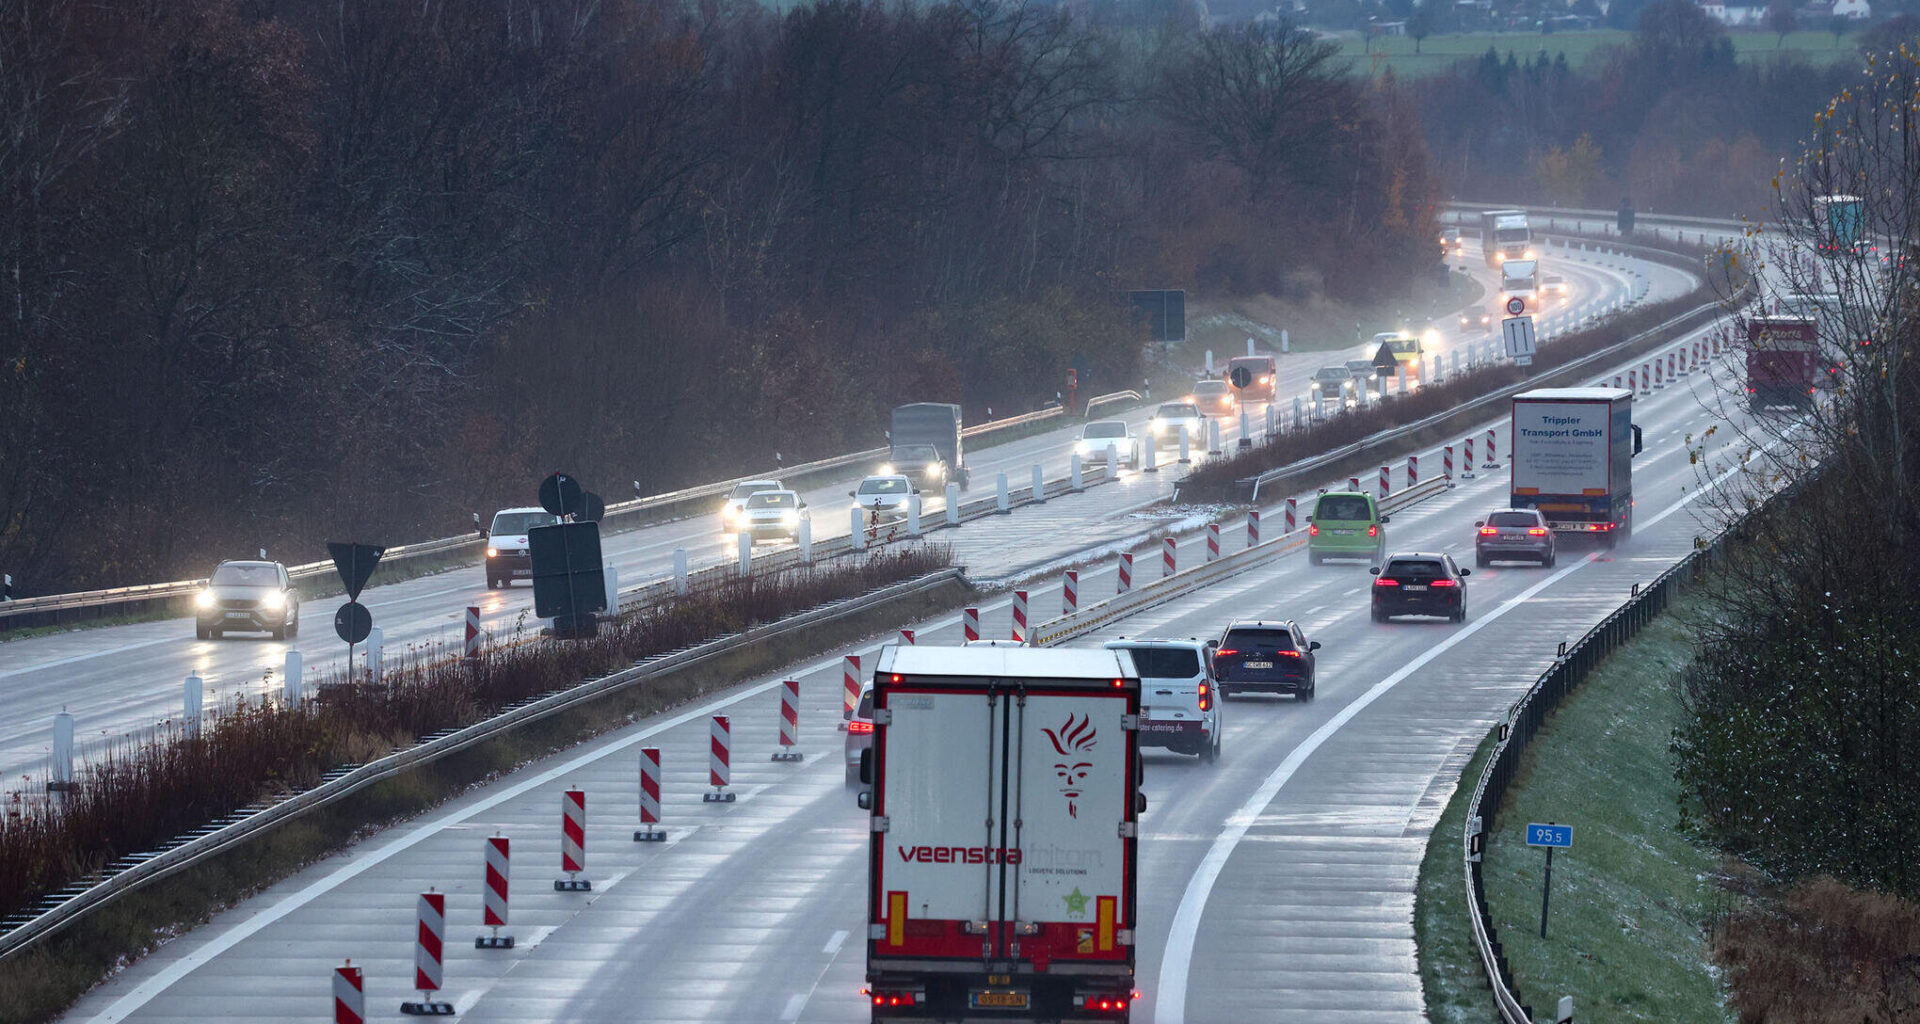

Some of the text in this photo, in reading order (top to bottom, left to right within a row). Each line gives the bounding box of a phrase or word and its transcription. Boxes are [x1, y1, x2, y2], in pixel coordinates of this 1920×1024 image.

[1510, 301, 1522, 311] 100
[1542, 415, 1581, 426] Trippler
[1521, 429, 1603, 438] Transport GmbH
[898, 845, 1023, 865] veenstra
[1056, 867, 1087, 875] SOLUTIONS
